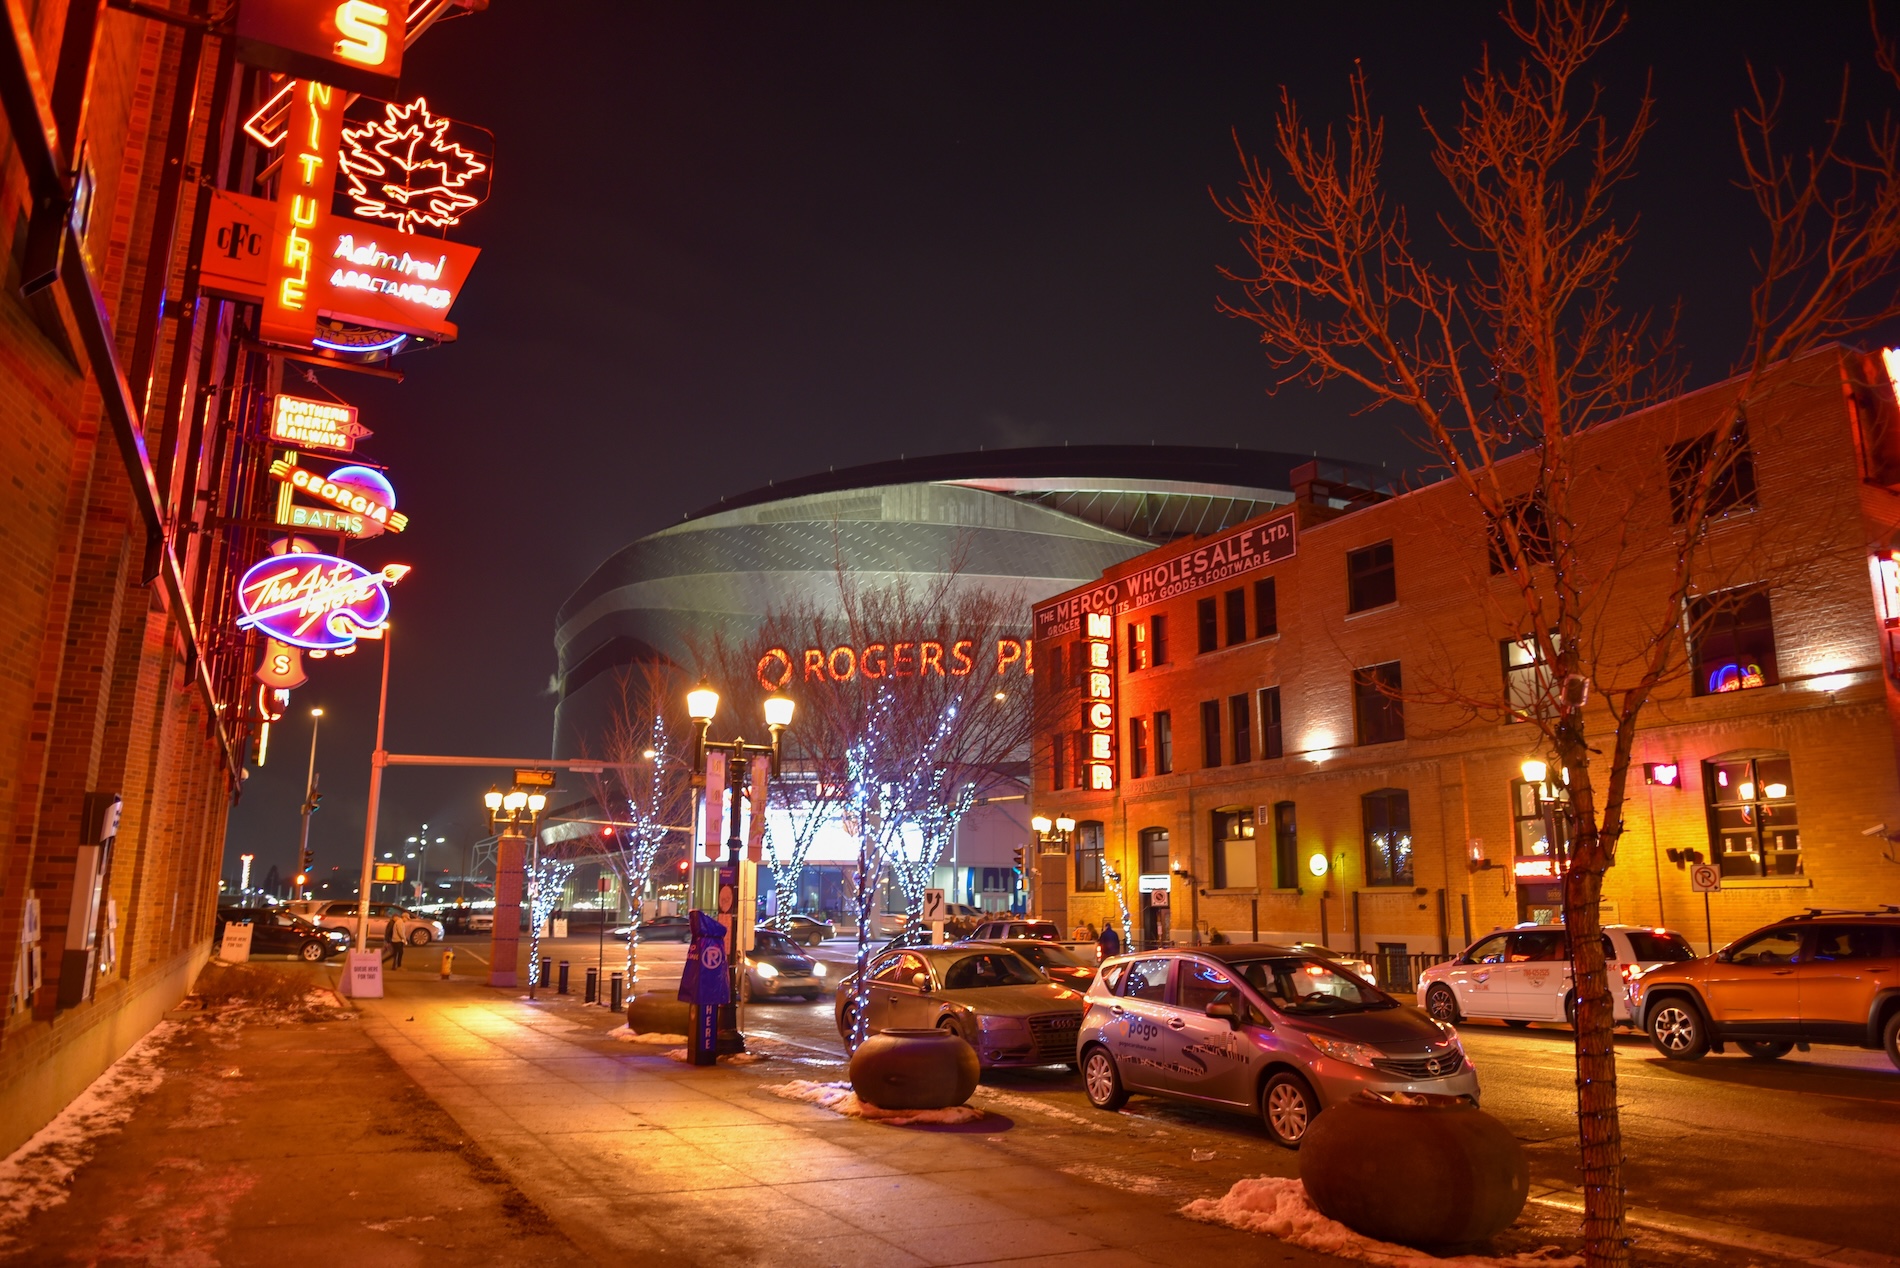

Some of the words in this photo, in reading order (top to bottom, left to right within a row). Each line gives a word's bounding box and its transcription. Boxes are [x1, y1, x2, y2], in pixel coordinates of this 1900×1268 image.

[216, 221, 262, 262] CFC
[277, 410, 337, 433] ALBERTA
[279, 396, 349, 423] NORTHERN
[276, 421, 347, 448] RAILWAYS
[292, 470, 388, 524] GEORGIA
[293, 508, 364, 533] BATHS
[243, 567, 300, 614] The
[290, 562, 354, 606] Art
[1039, 610, 1055, 625] THE
[1056, 585, 1119, 622] MERCO
[1126, 532, 1254, 597] WHOLESALE
[1261, 524, 1290, 546] LTD.
[1136, 589, 1158, 607] DRY
[1159, 576, 1197, 599] GOODS
[1205, 550, 1271, 583] FOOTWARE
[804, 640, 974, 683] ROGERS
[1087, 612, 1113, 790] MERCER
[704, 1004, 713, 1050] HERE
[1128, 1022, 1158, 1041] pogo
